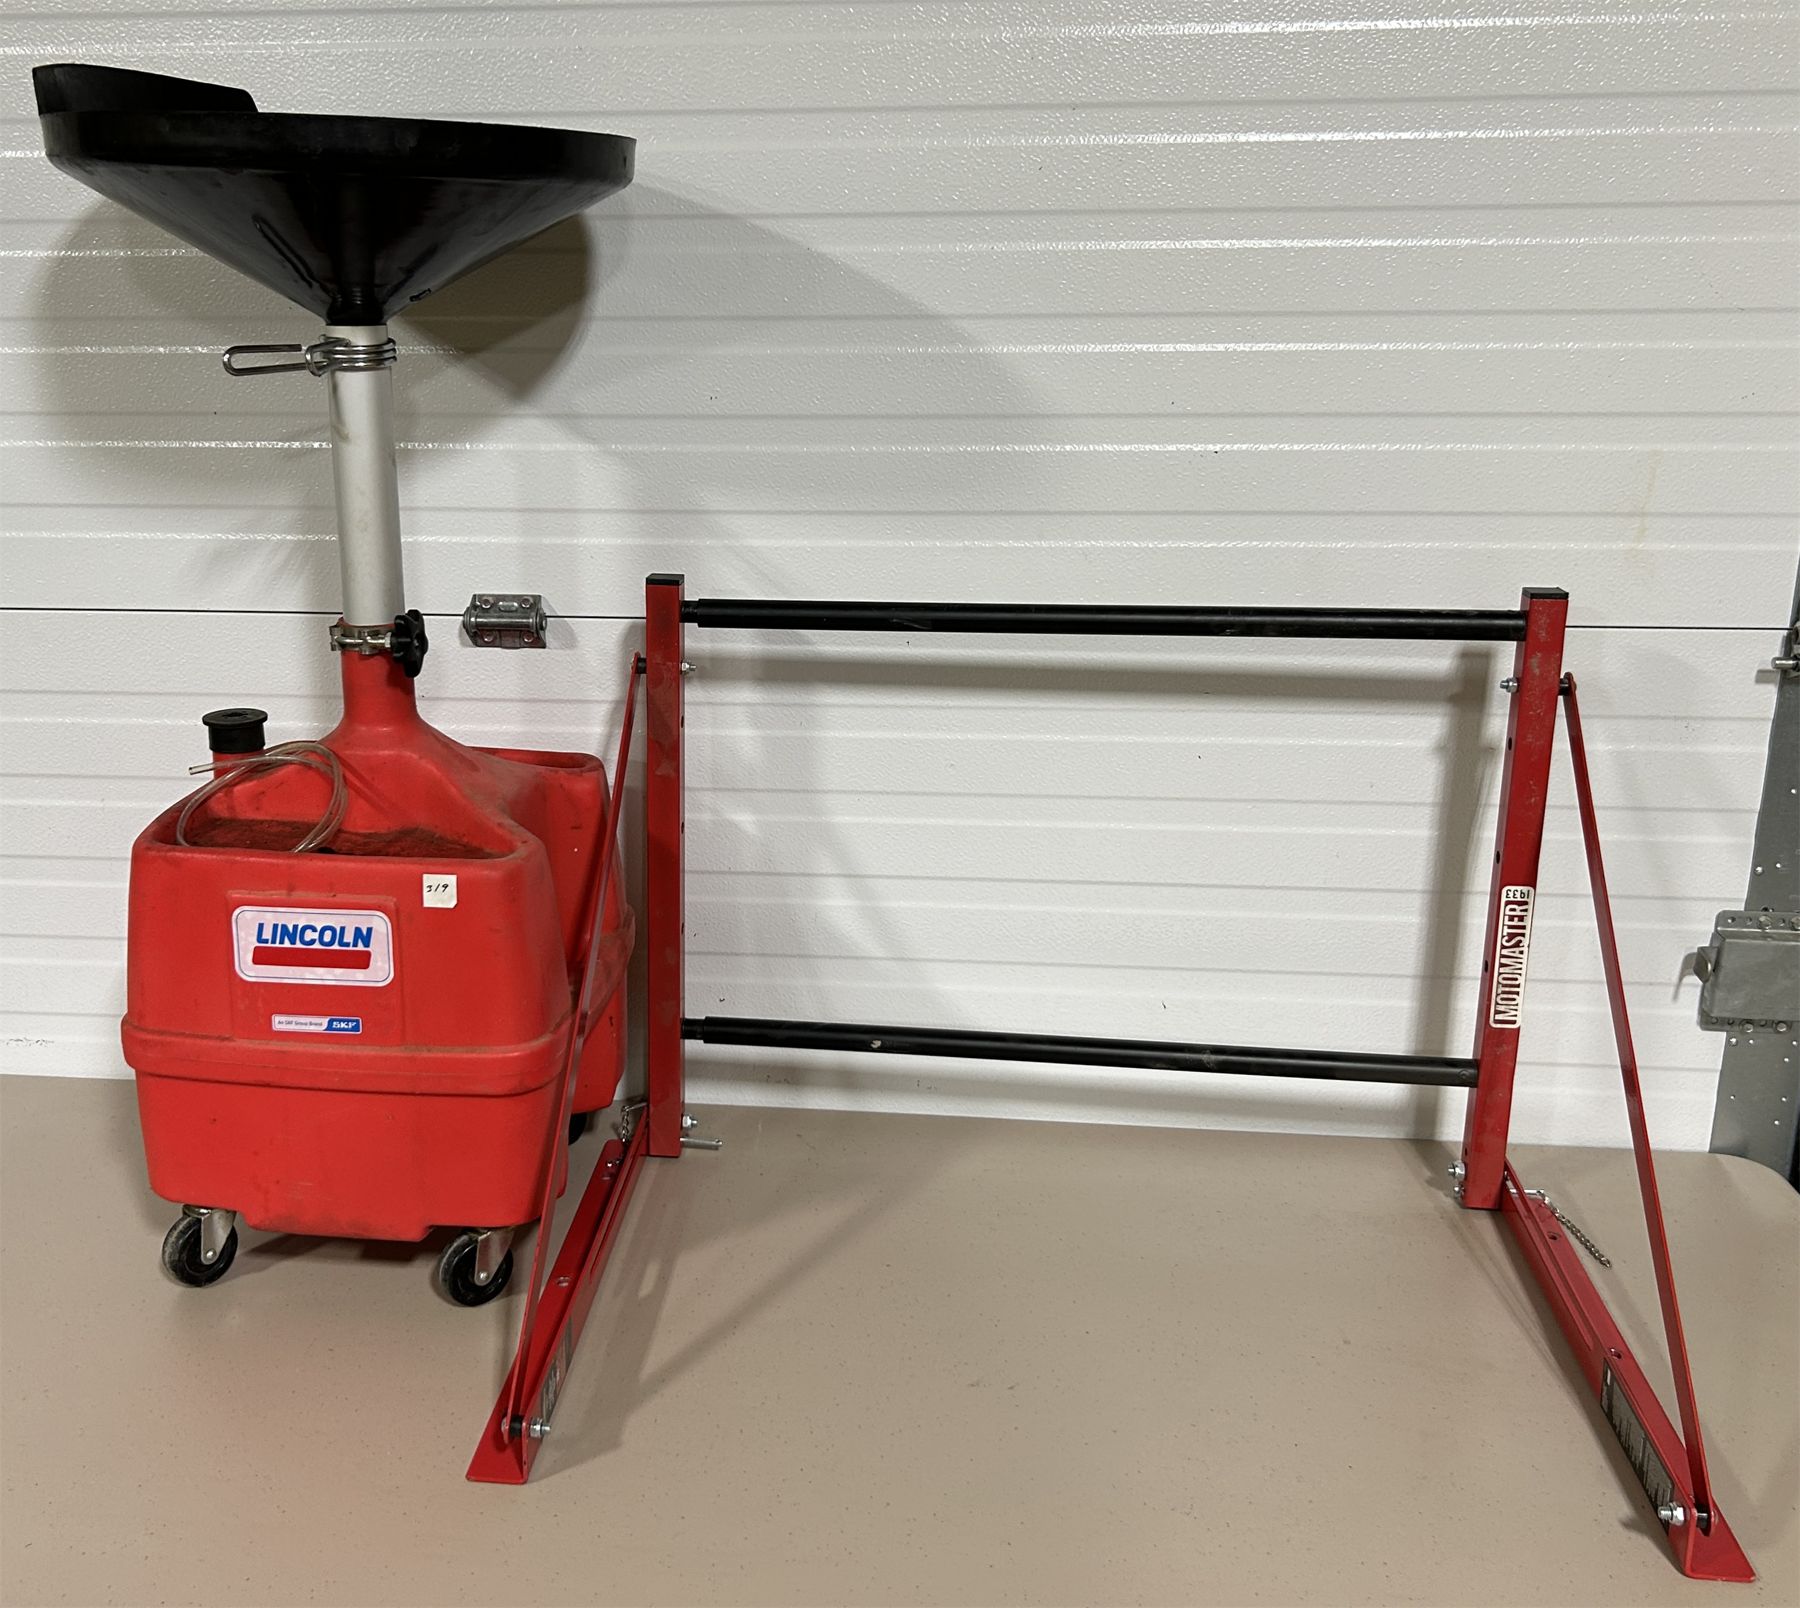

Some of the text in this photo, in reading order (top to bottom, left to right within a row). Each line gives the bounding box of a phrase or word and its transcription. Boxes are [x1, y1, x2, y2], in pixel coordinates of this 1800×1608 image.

[1505, 888, 1531, 900] 1933
[256, 922, 373, 948] LINCOLN
[1494, 903, 1529, 1021] MOTOMASTER
[332, 1021, 357, 1029] SKF
